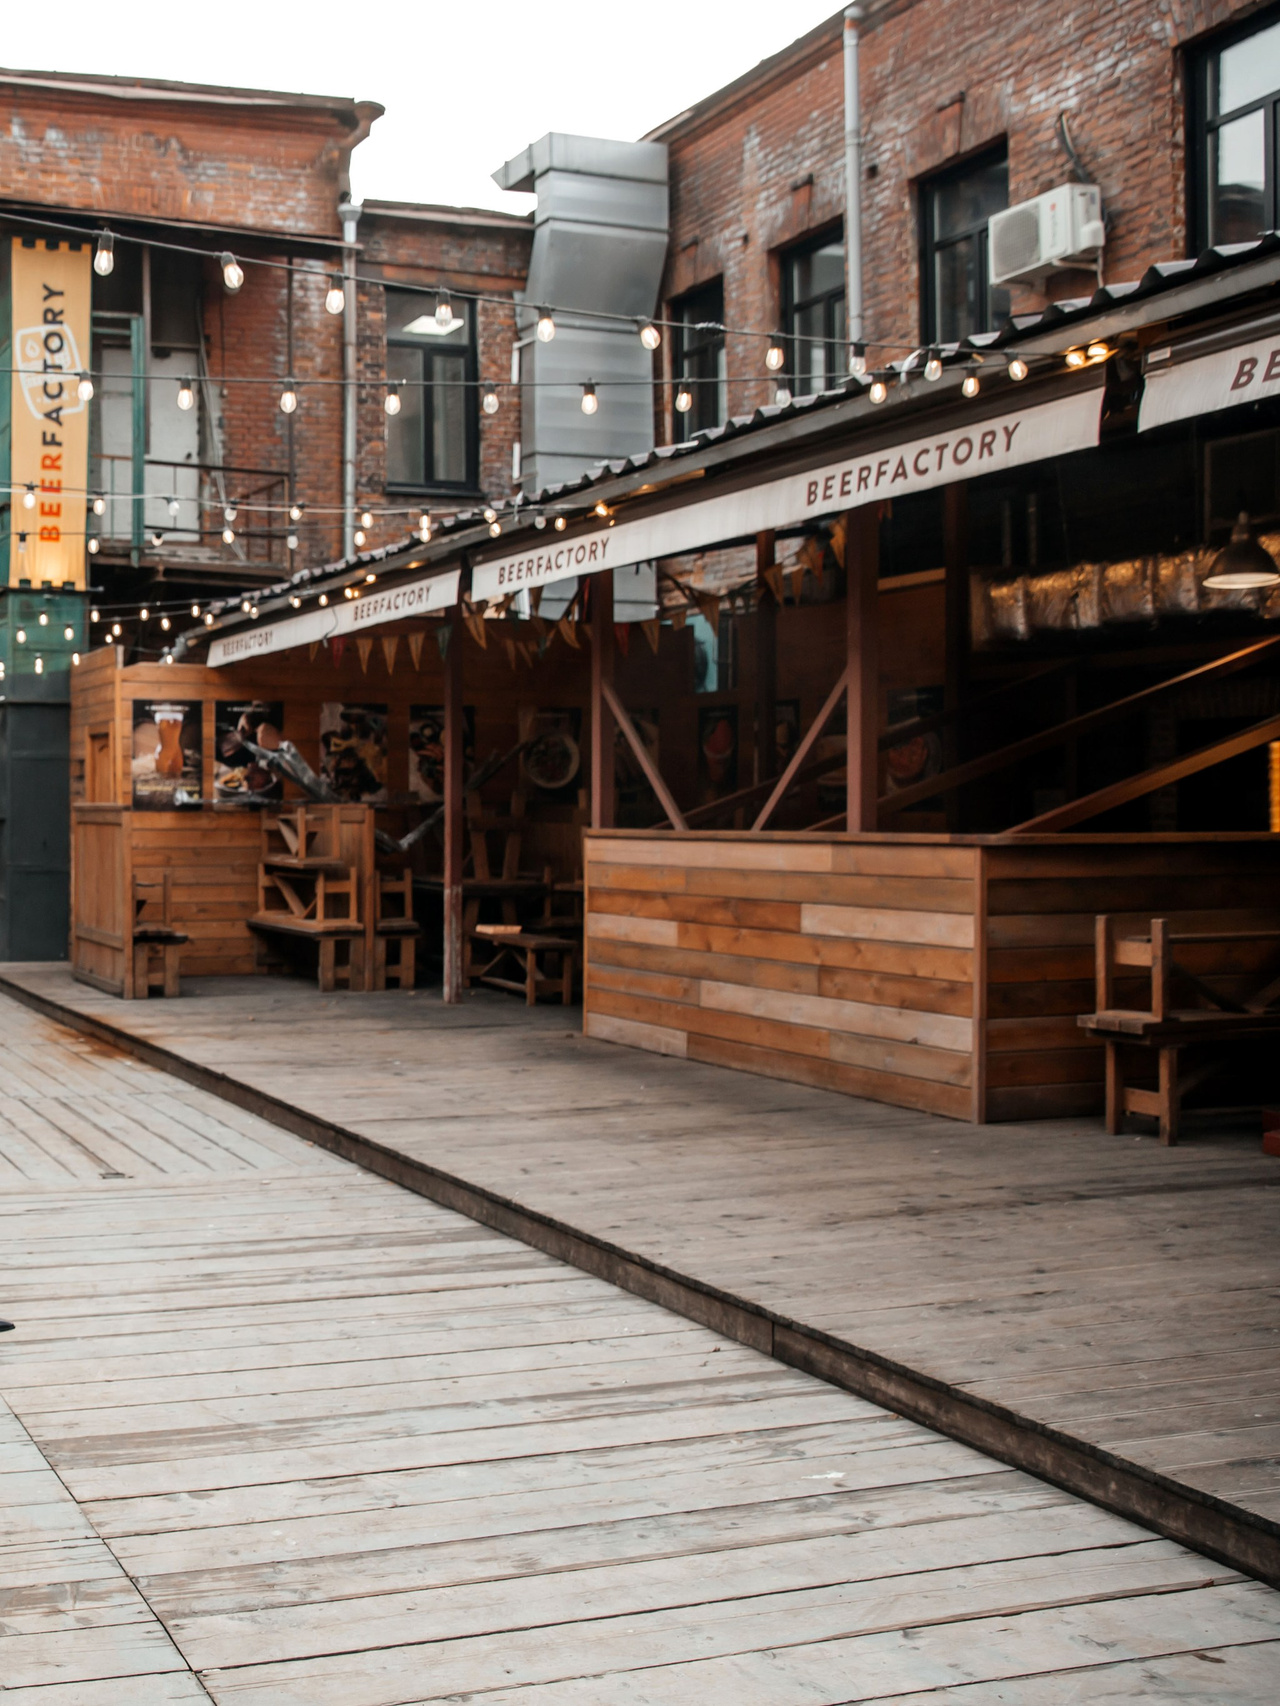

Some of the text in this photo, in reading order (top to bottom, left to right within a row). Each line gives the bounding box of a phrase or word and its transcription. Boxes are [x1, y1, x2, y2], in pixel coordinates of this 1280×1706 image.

[40, 283, 64, 542] BEERFACTORY
[807, 421, 1021, 506] BEERFACTORY
[498, 537, 610, 585] BEERFACTORY
[353, 585, 432, 621] BEERFACTORY
[222, 631, 273, 656] BEERFACTORY
